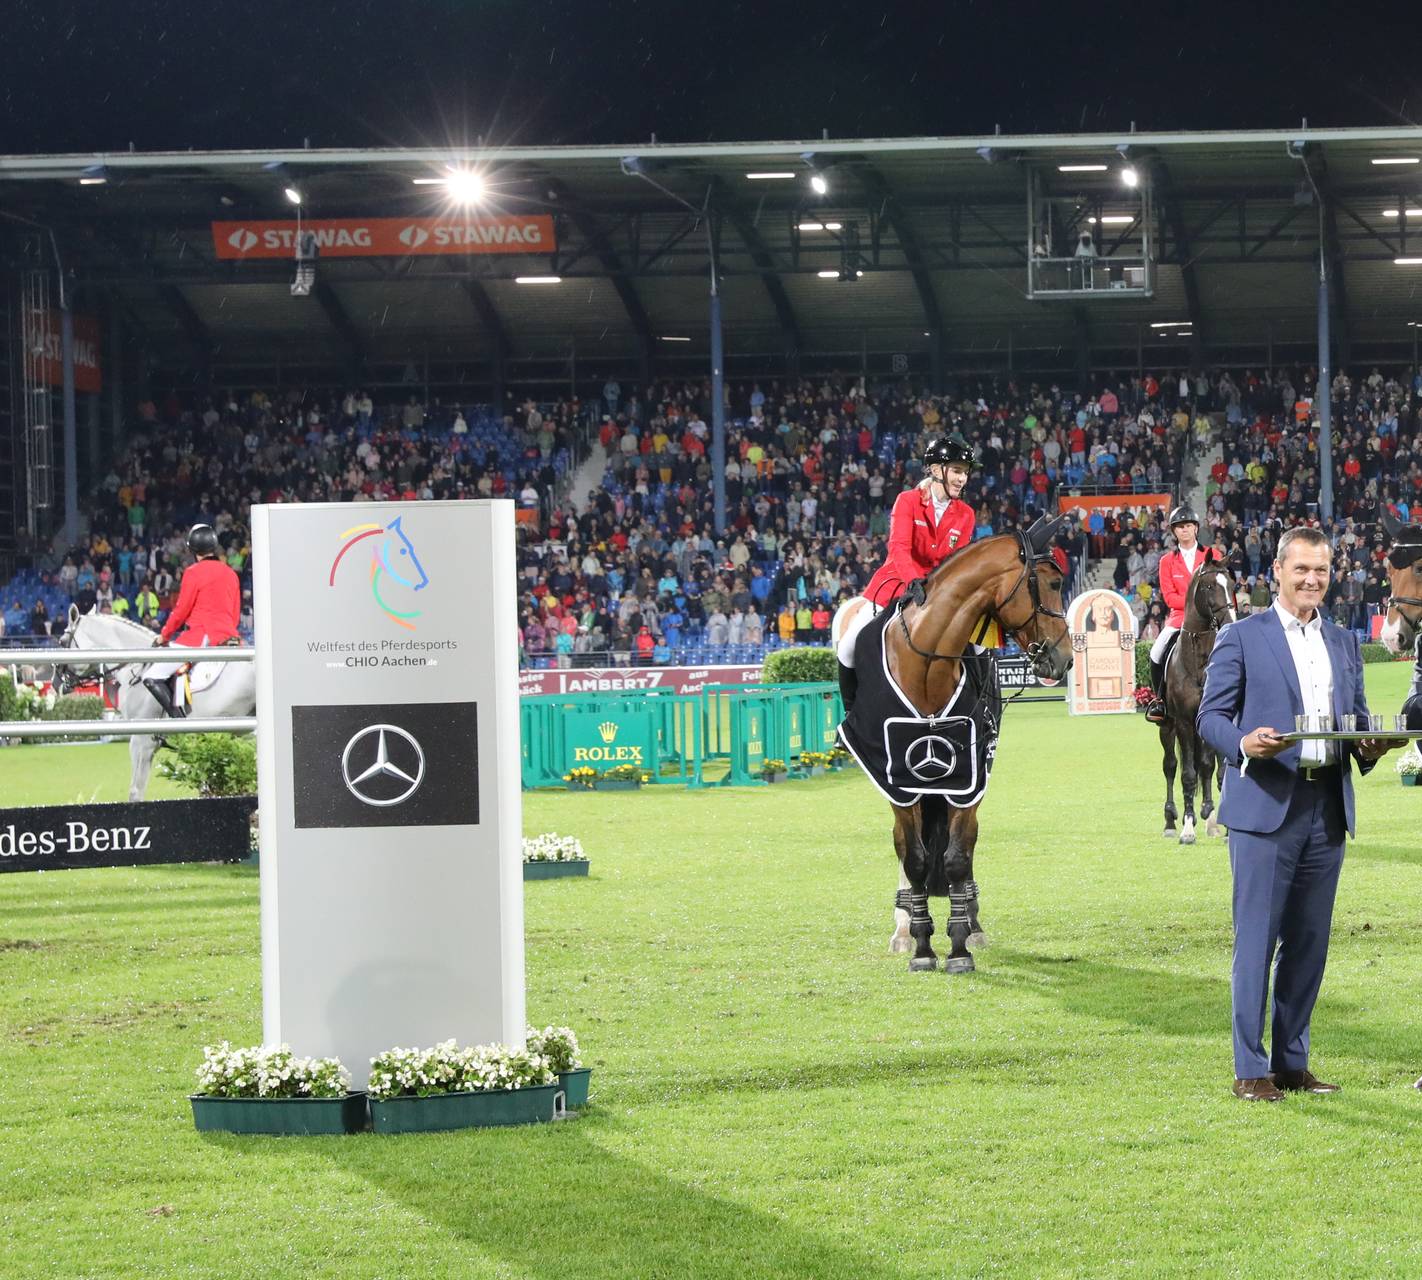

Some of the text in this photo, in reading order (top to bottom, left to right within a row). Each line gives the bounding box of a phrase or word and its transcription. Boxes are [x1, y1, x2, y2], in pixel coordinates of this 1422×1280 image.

[434, 224, 542, 245] STAWAG
[891, 353, 909, 372] B
[306, 639, 458, 653] Weltfest des Pferdesports
[688, 669, 709, 680] aus
[574, 746, 644, 761] ROLEX
[0, 821, 151, 857] des-Benz
